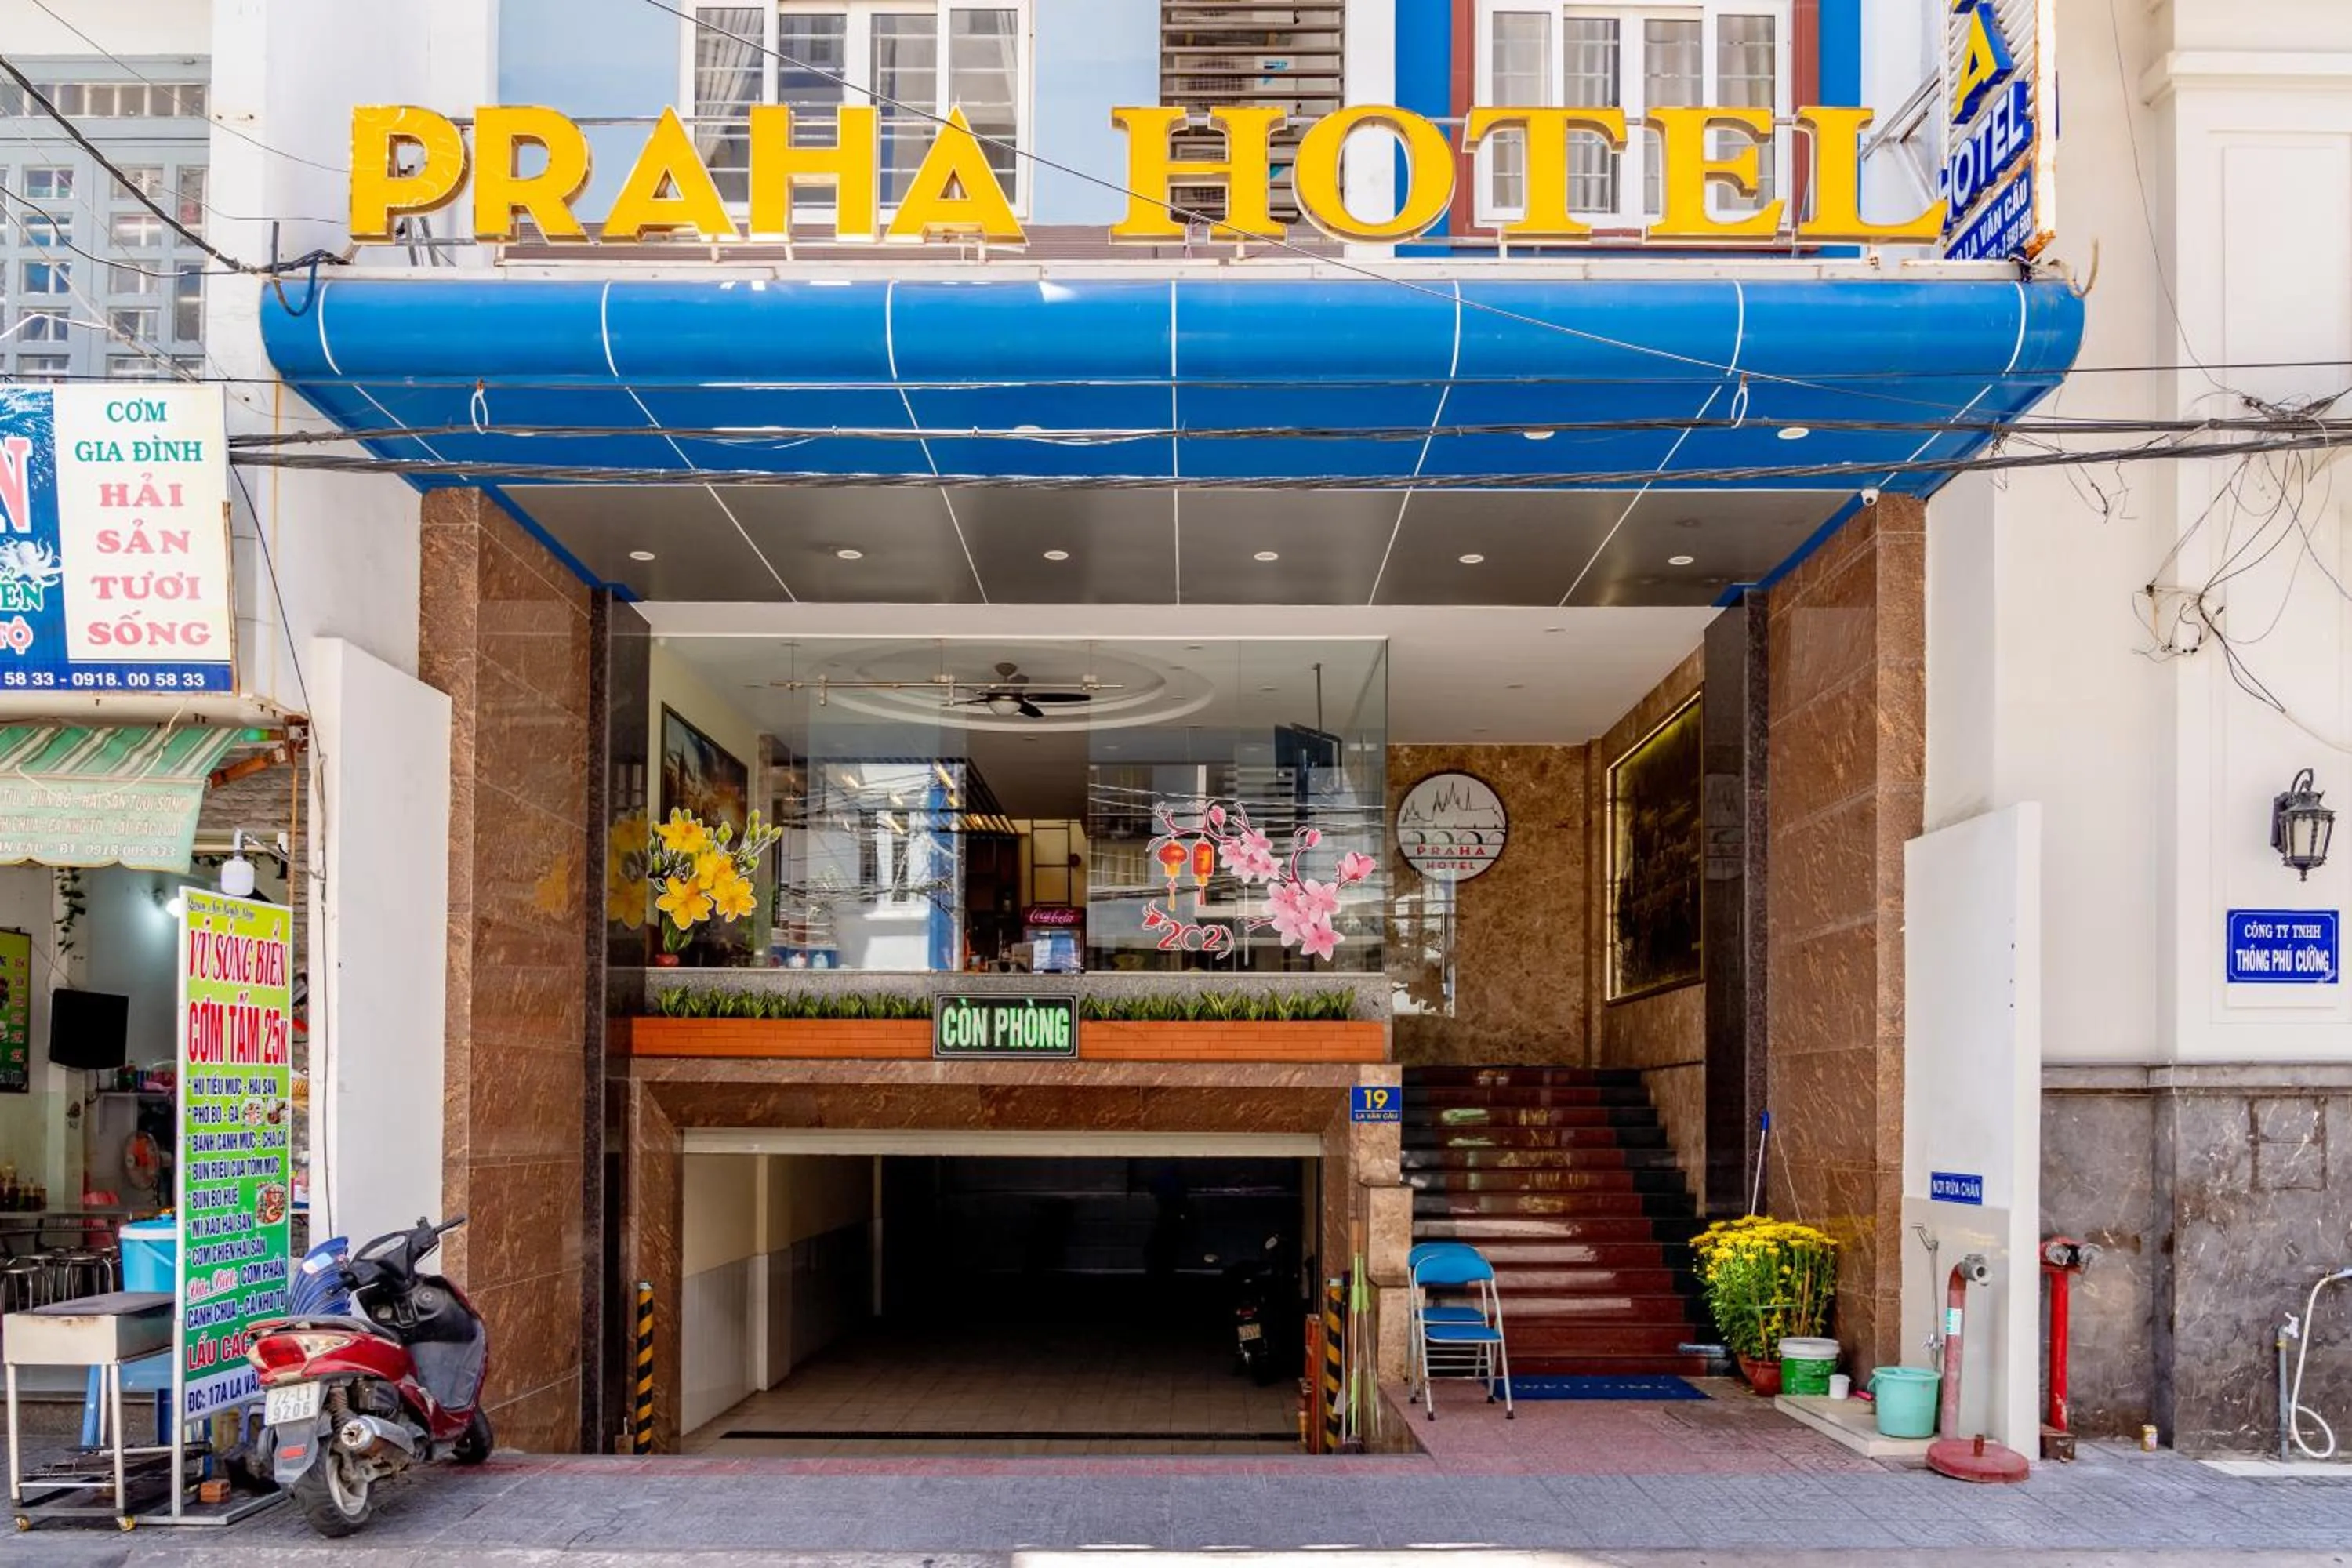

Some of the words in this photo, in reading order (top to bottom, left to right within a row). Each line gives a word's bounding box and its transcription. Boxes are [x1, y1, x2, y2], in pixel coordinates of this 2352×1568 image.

[1938, 82, 2027, 224] HOTEL
[350, 105, 1029, 245] PRAHA
[1109, 106, 1949, 245] HOTEL
[107, 398, 168, 423] CƠM
[75, 441, 125, 462] GIA
[133, 434, 204, 462] ĐÌNH
[98, 473, 184, 508] HẢI
[96, 519, 191, 554] SẢN
[91, 571, 201, 600] TƯƠI
[87, 610, 212, 647] SỐNG
[5, 672, 27, 686] 58
[32, 672, 54, 685] 33
[128, 672, 150, 686] 00
[155, 672, 178, 686] 58
[183, 672, 205, 686] 33
[1417, 846, 1485, 855] PRAHA
[1426, 861, 1475, 869] HOTEL
[2244, 920, 2274, 938] CÔNG
[2276, 924, 2289, 938] TY
[2292, 924, 2321, 938] TNHH
[212, 922, 254, 983] SÓNG
[2235, 943, 2270, 971] THÔNG
[2272, 943, 2293, 971] PHÚ
[188, 996, 223, 1063] CƠM
[228, 993, 260, 1064] TẤM
[942, 998, 988, 1047] CÒN
[993, 998, 1070, 1047] PHÒNG
[1364, 1090, 1388, 1109] 19
[209, 1381, 227, 1405] 17A
[230, 1377, 241, 1399] LA
